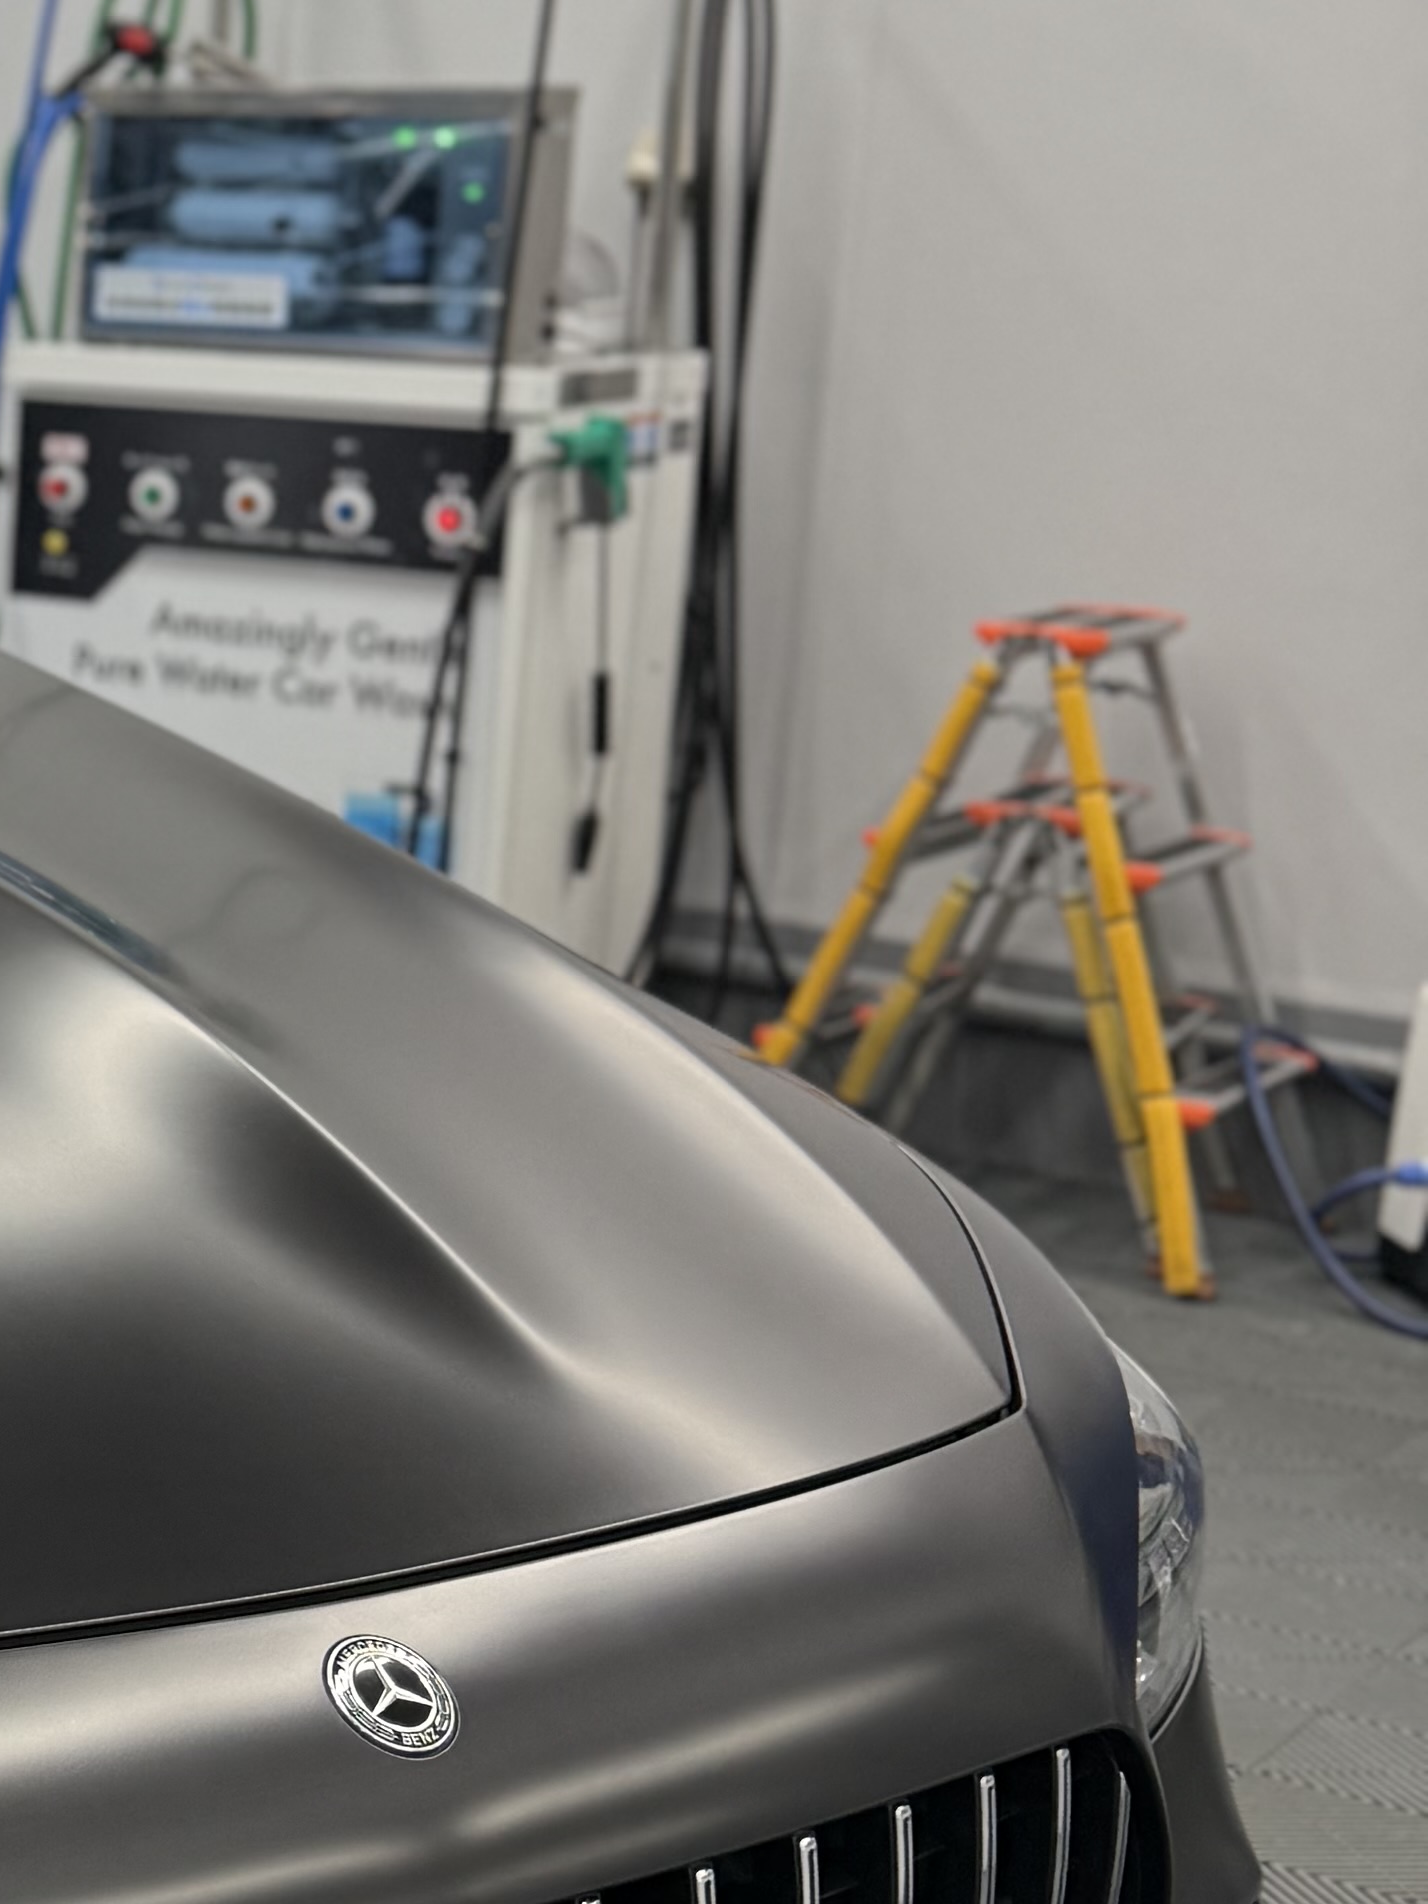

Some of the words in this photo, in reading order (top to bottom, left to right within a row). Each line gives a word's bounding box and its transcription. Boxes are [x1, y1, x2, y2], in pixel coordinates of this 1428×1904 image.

[151, 600, 338, 663] Amazingly
[346, 617, 446, 668] Gen
[71, 643, 143, 684] Pure
[155, 654, 261, 696] Water
[272, 663, 338, 707] Car
[400, 1726, 440, 1746] BENZ
